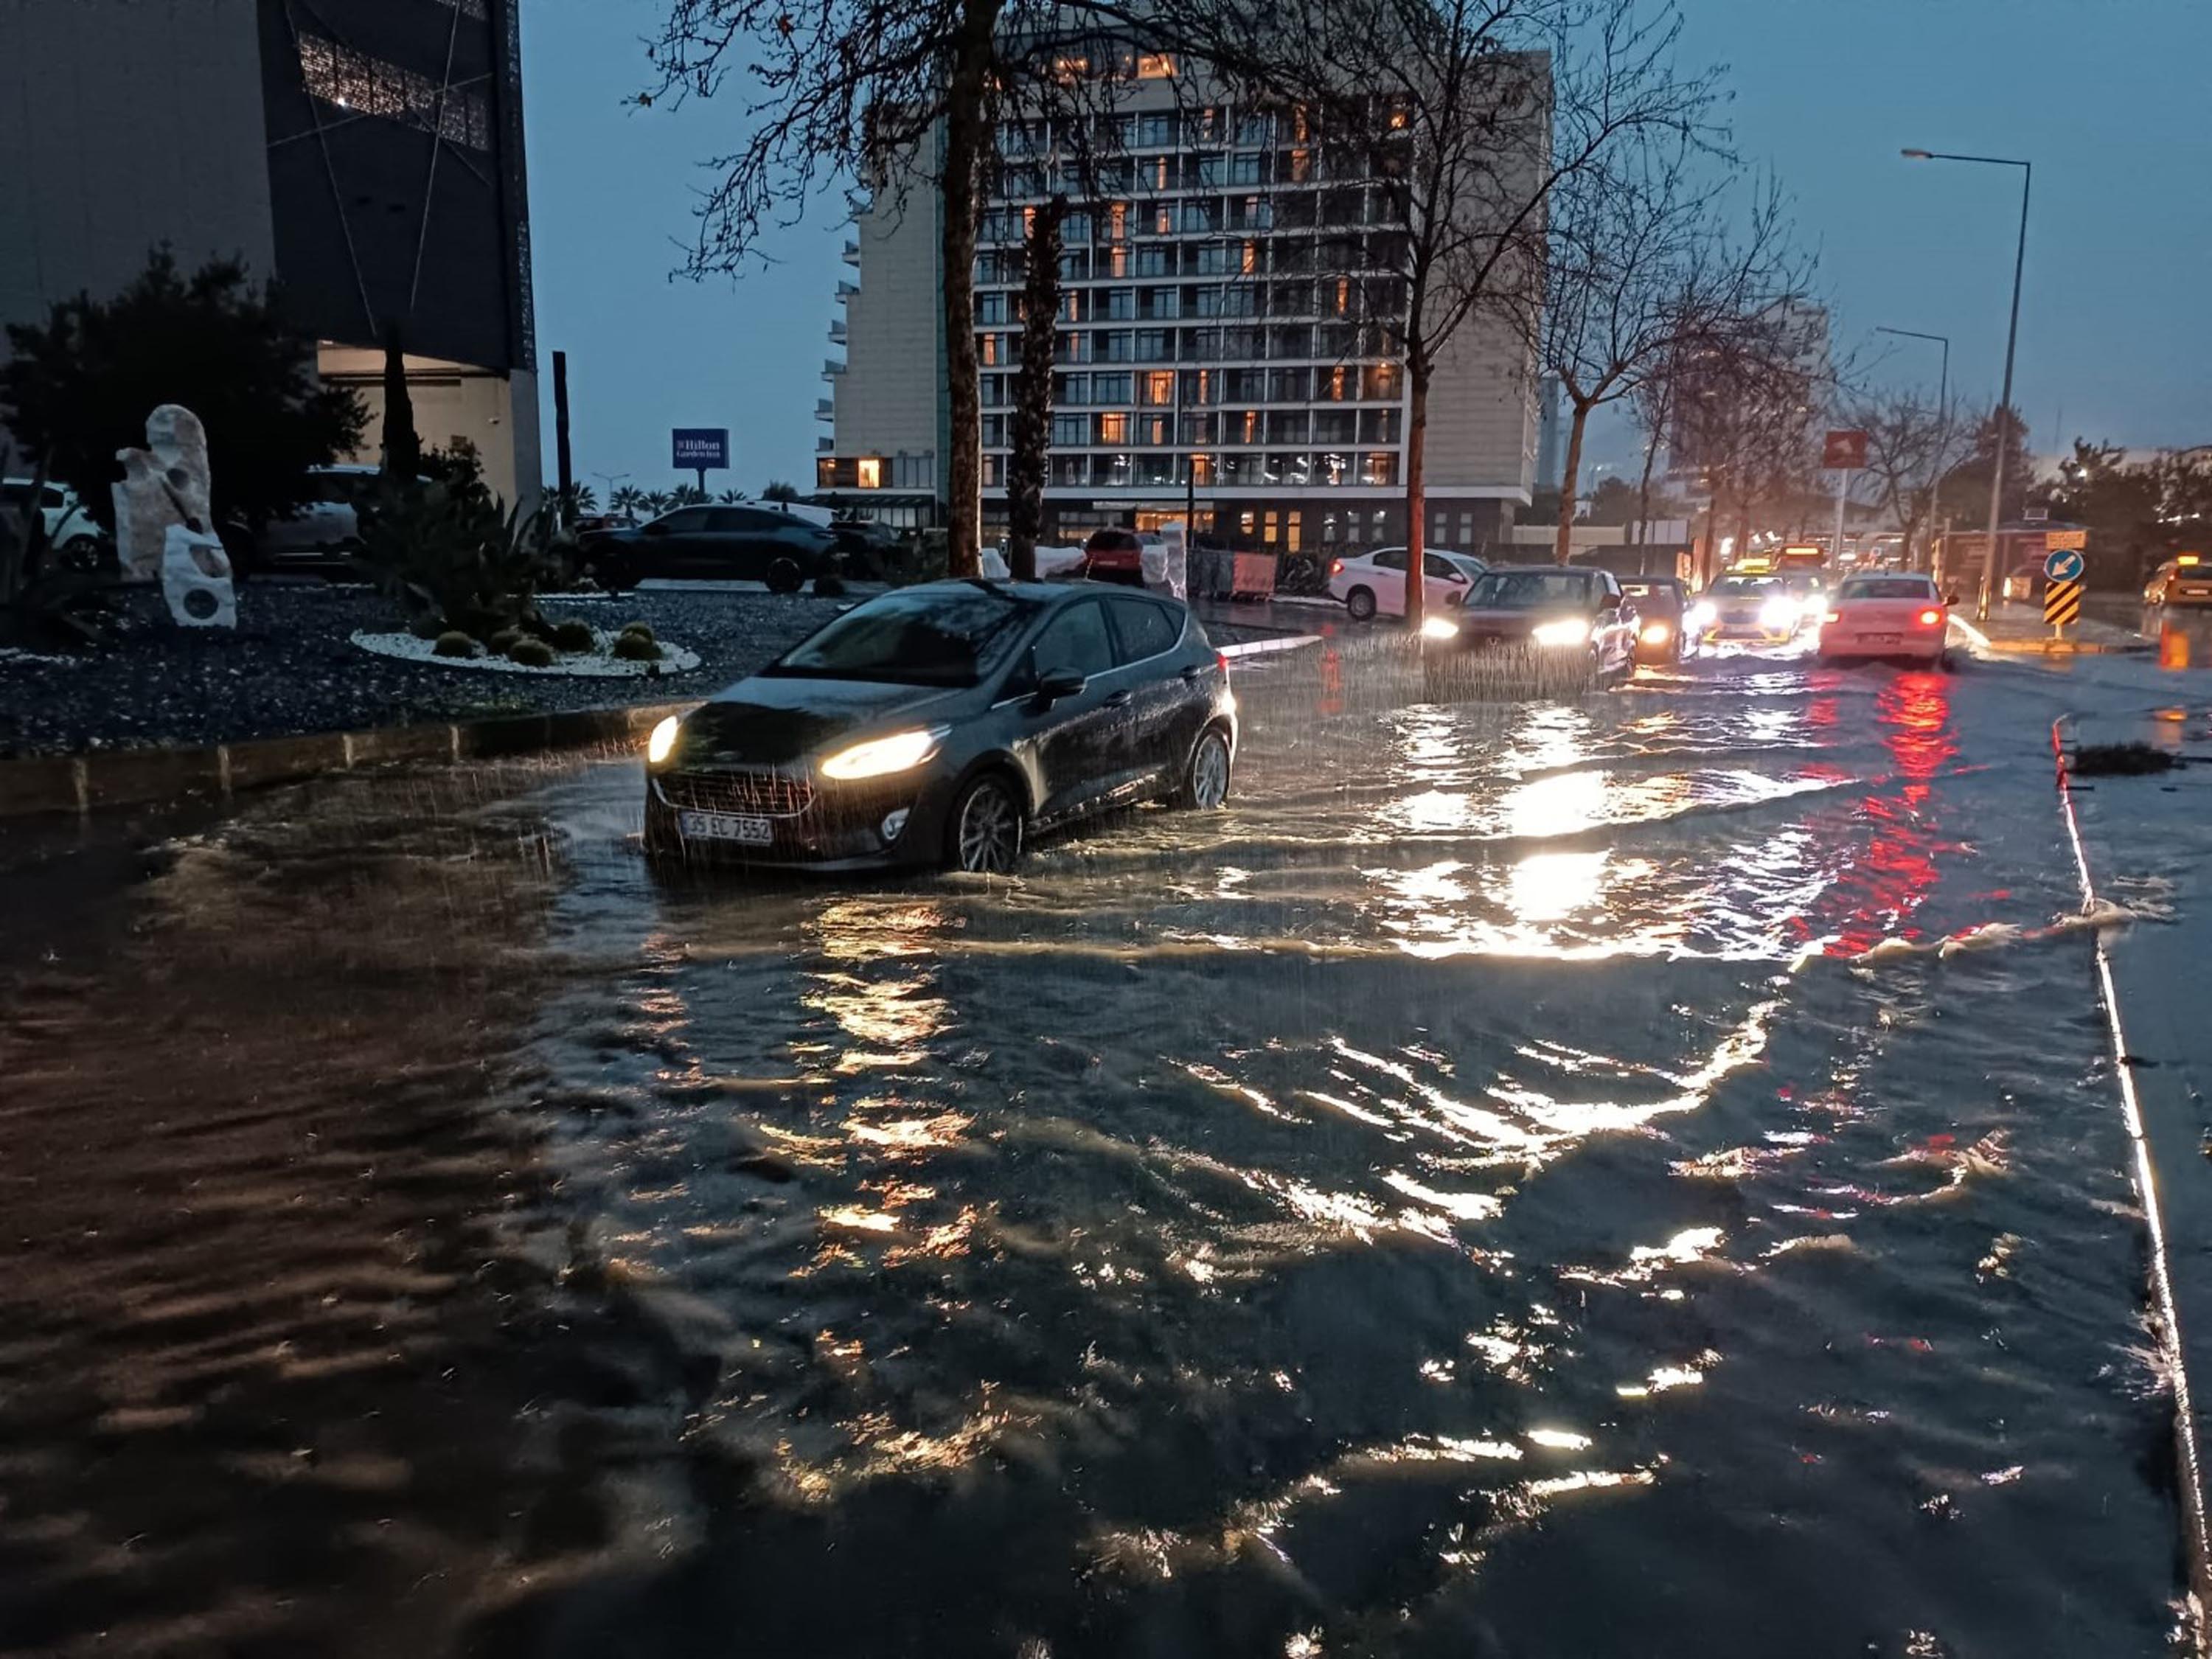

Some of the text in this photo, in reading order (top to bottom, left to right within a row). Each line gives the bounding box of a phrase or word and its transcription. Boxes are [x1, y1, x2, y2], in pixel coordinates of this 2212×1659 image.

[686, 439, 720, 450] Hilton
[689, 815, 706, 832] 35
[733, 820, 769, 839] 7552
